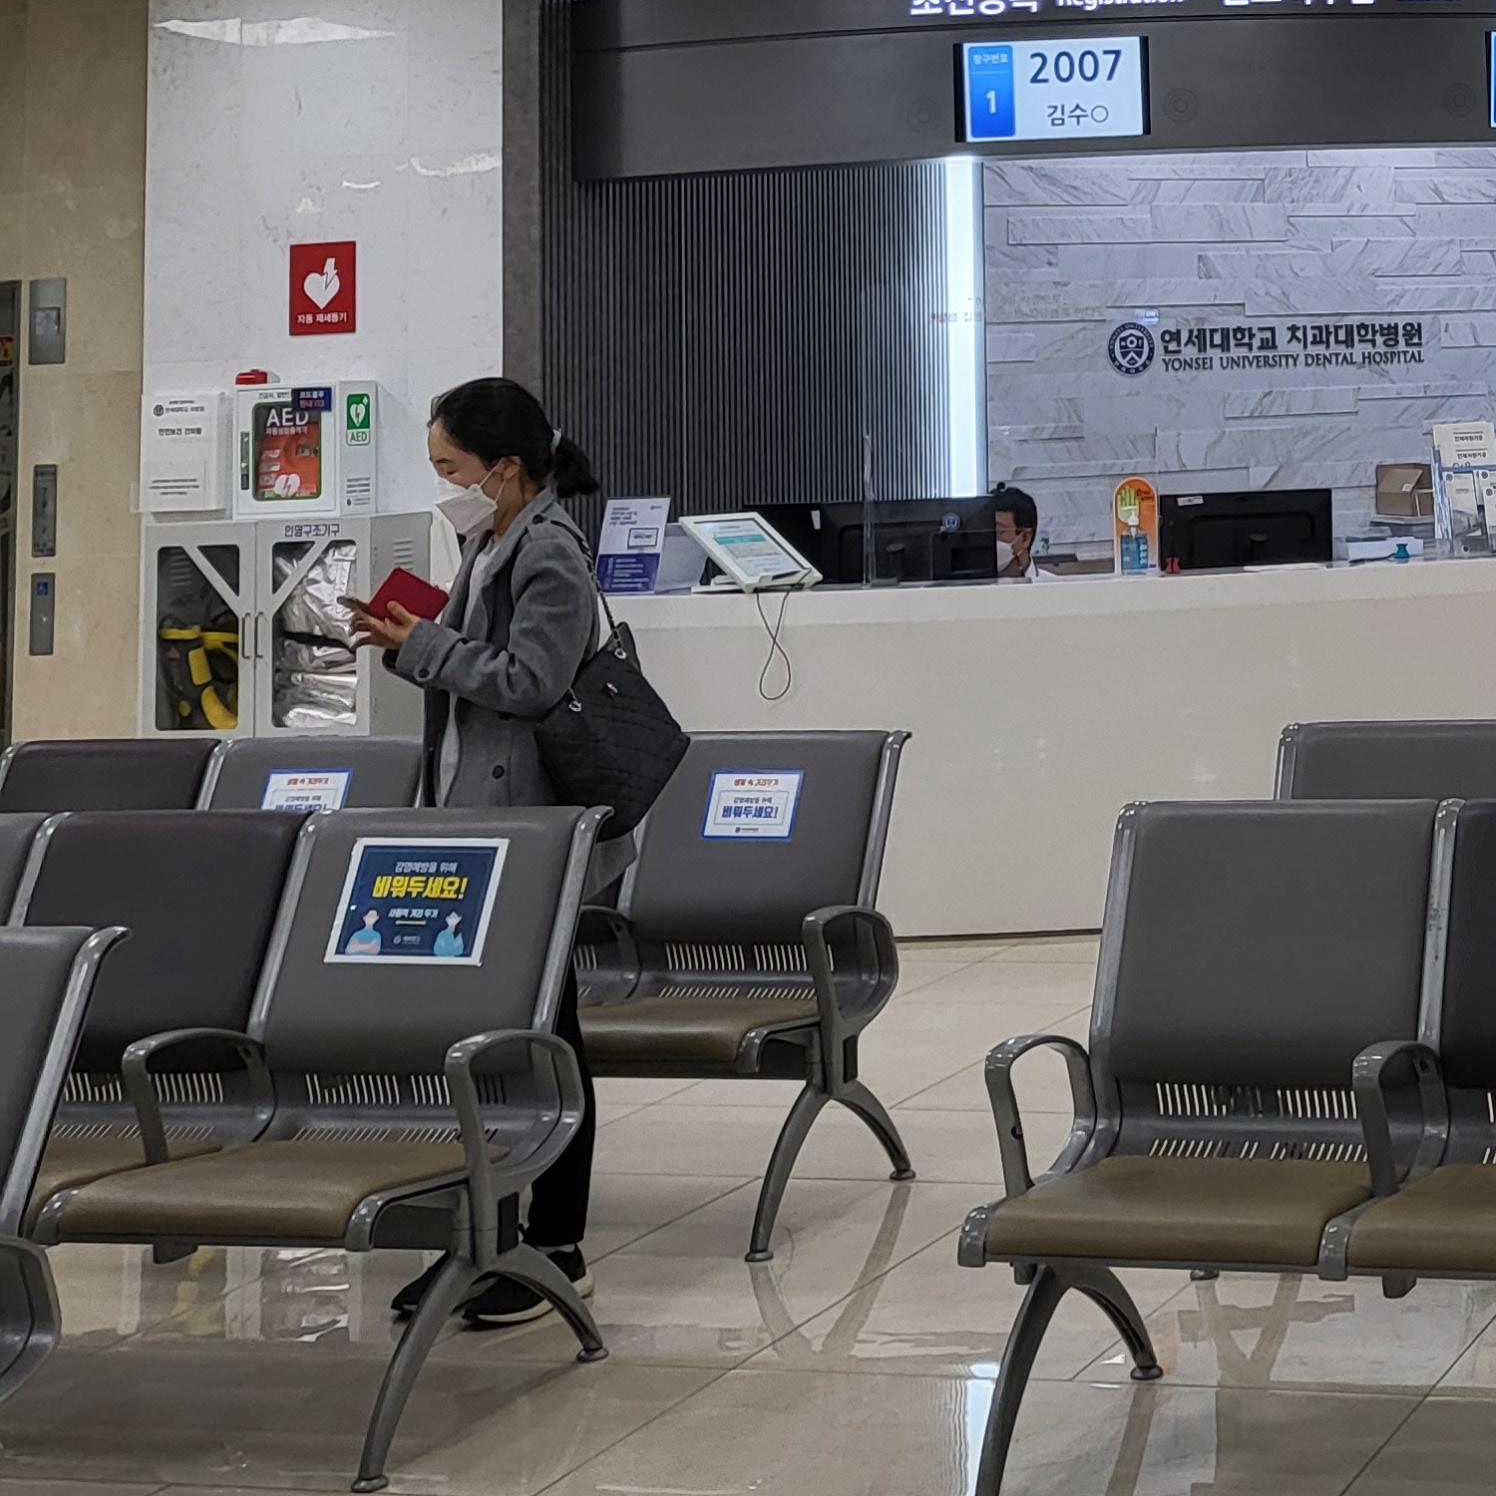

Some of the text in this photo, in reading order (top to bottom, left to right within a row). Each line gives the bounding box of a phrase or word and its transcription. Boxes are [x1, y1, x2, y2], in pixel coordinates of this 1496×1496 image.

[1030, 49, 1122, 84] 2007
[986, 90, 997, 114] 1
[1160, 326, 1279, 354] 연세대학교
[1287, 322, 1424, 350] 치과대학병원
[1161, 350, 1425, 372] YONSEI UNIVERSITY DENTAL HOSPITAL
[266, 407, 309, 427] AED
[350, 432, 367, 443] AED
[284, 523, 340, 538] 인명구조기구
[722, 805, 780, 819] 비워두세요!
[372, 875, 469, 899] 비워두세요!
